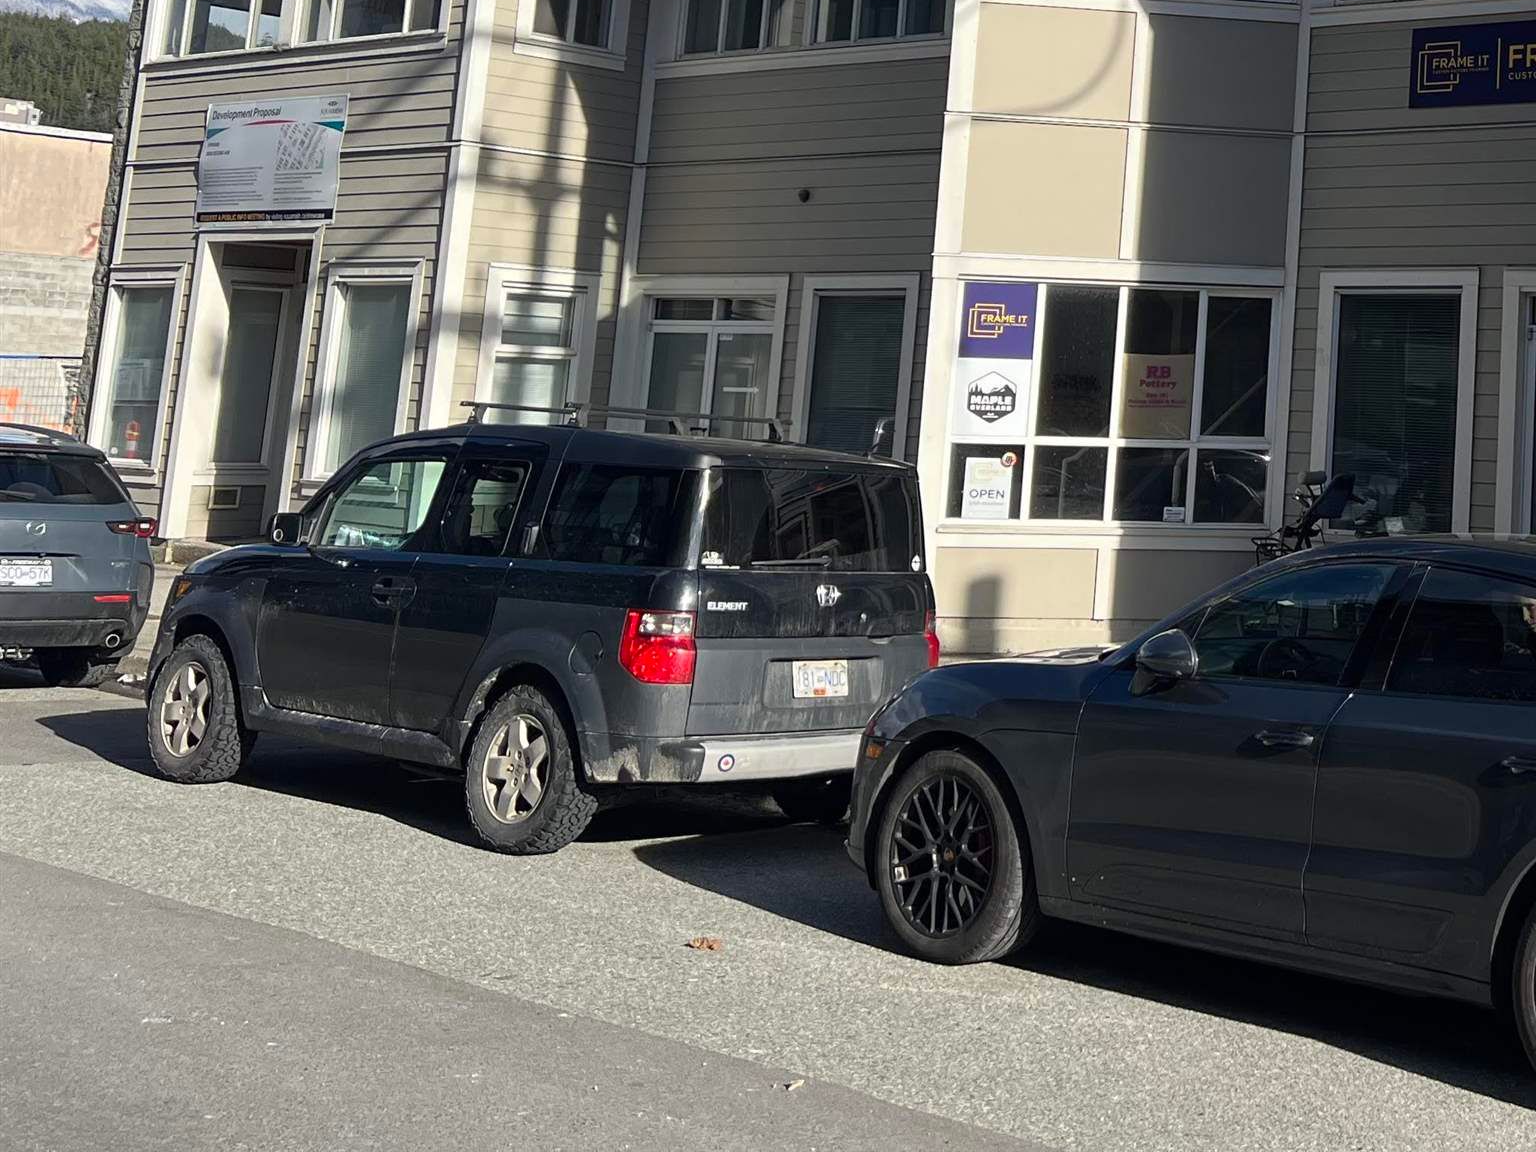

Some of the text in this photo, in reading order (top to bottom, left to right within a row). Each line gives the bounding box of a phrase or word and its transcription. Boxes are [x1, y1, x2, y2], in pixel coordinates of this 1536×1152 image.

[1432, 55, 1490, 68] FRAME IT
[212, 107, 282, 121] Development Proposal
[981, 314, 1028, 323] FRAME IT
[1139, 379, 1177, 390] Pottery
[970, 395, 1013, 405] MAPLE
[969, 489, 1005, 499] OPEN
[707, 602, 749, 612] ELEMENT
